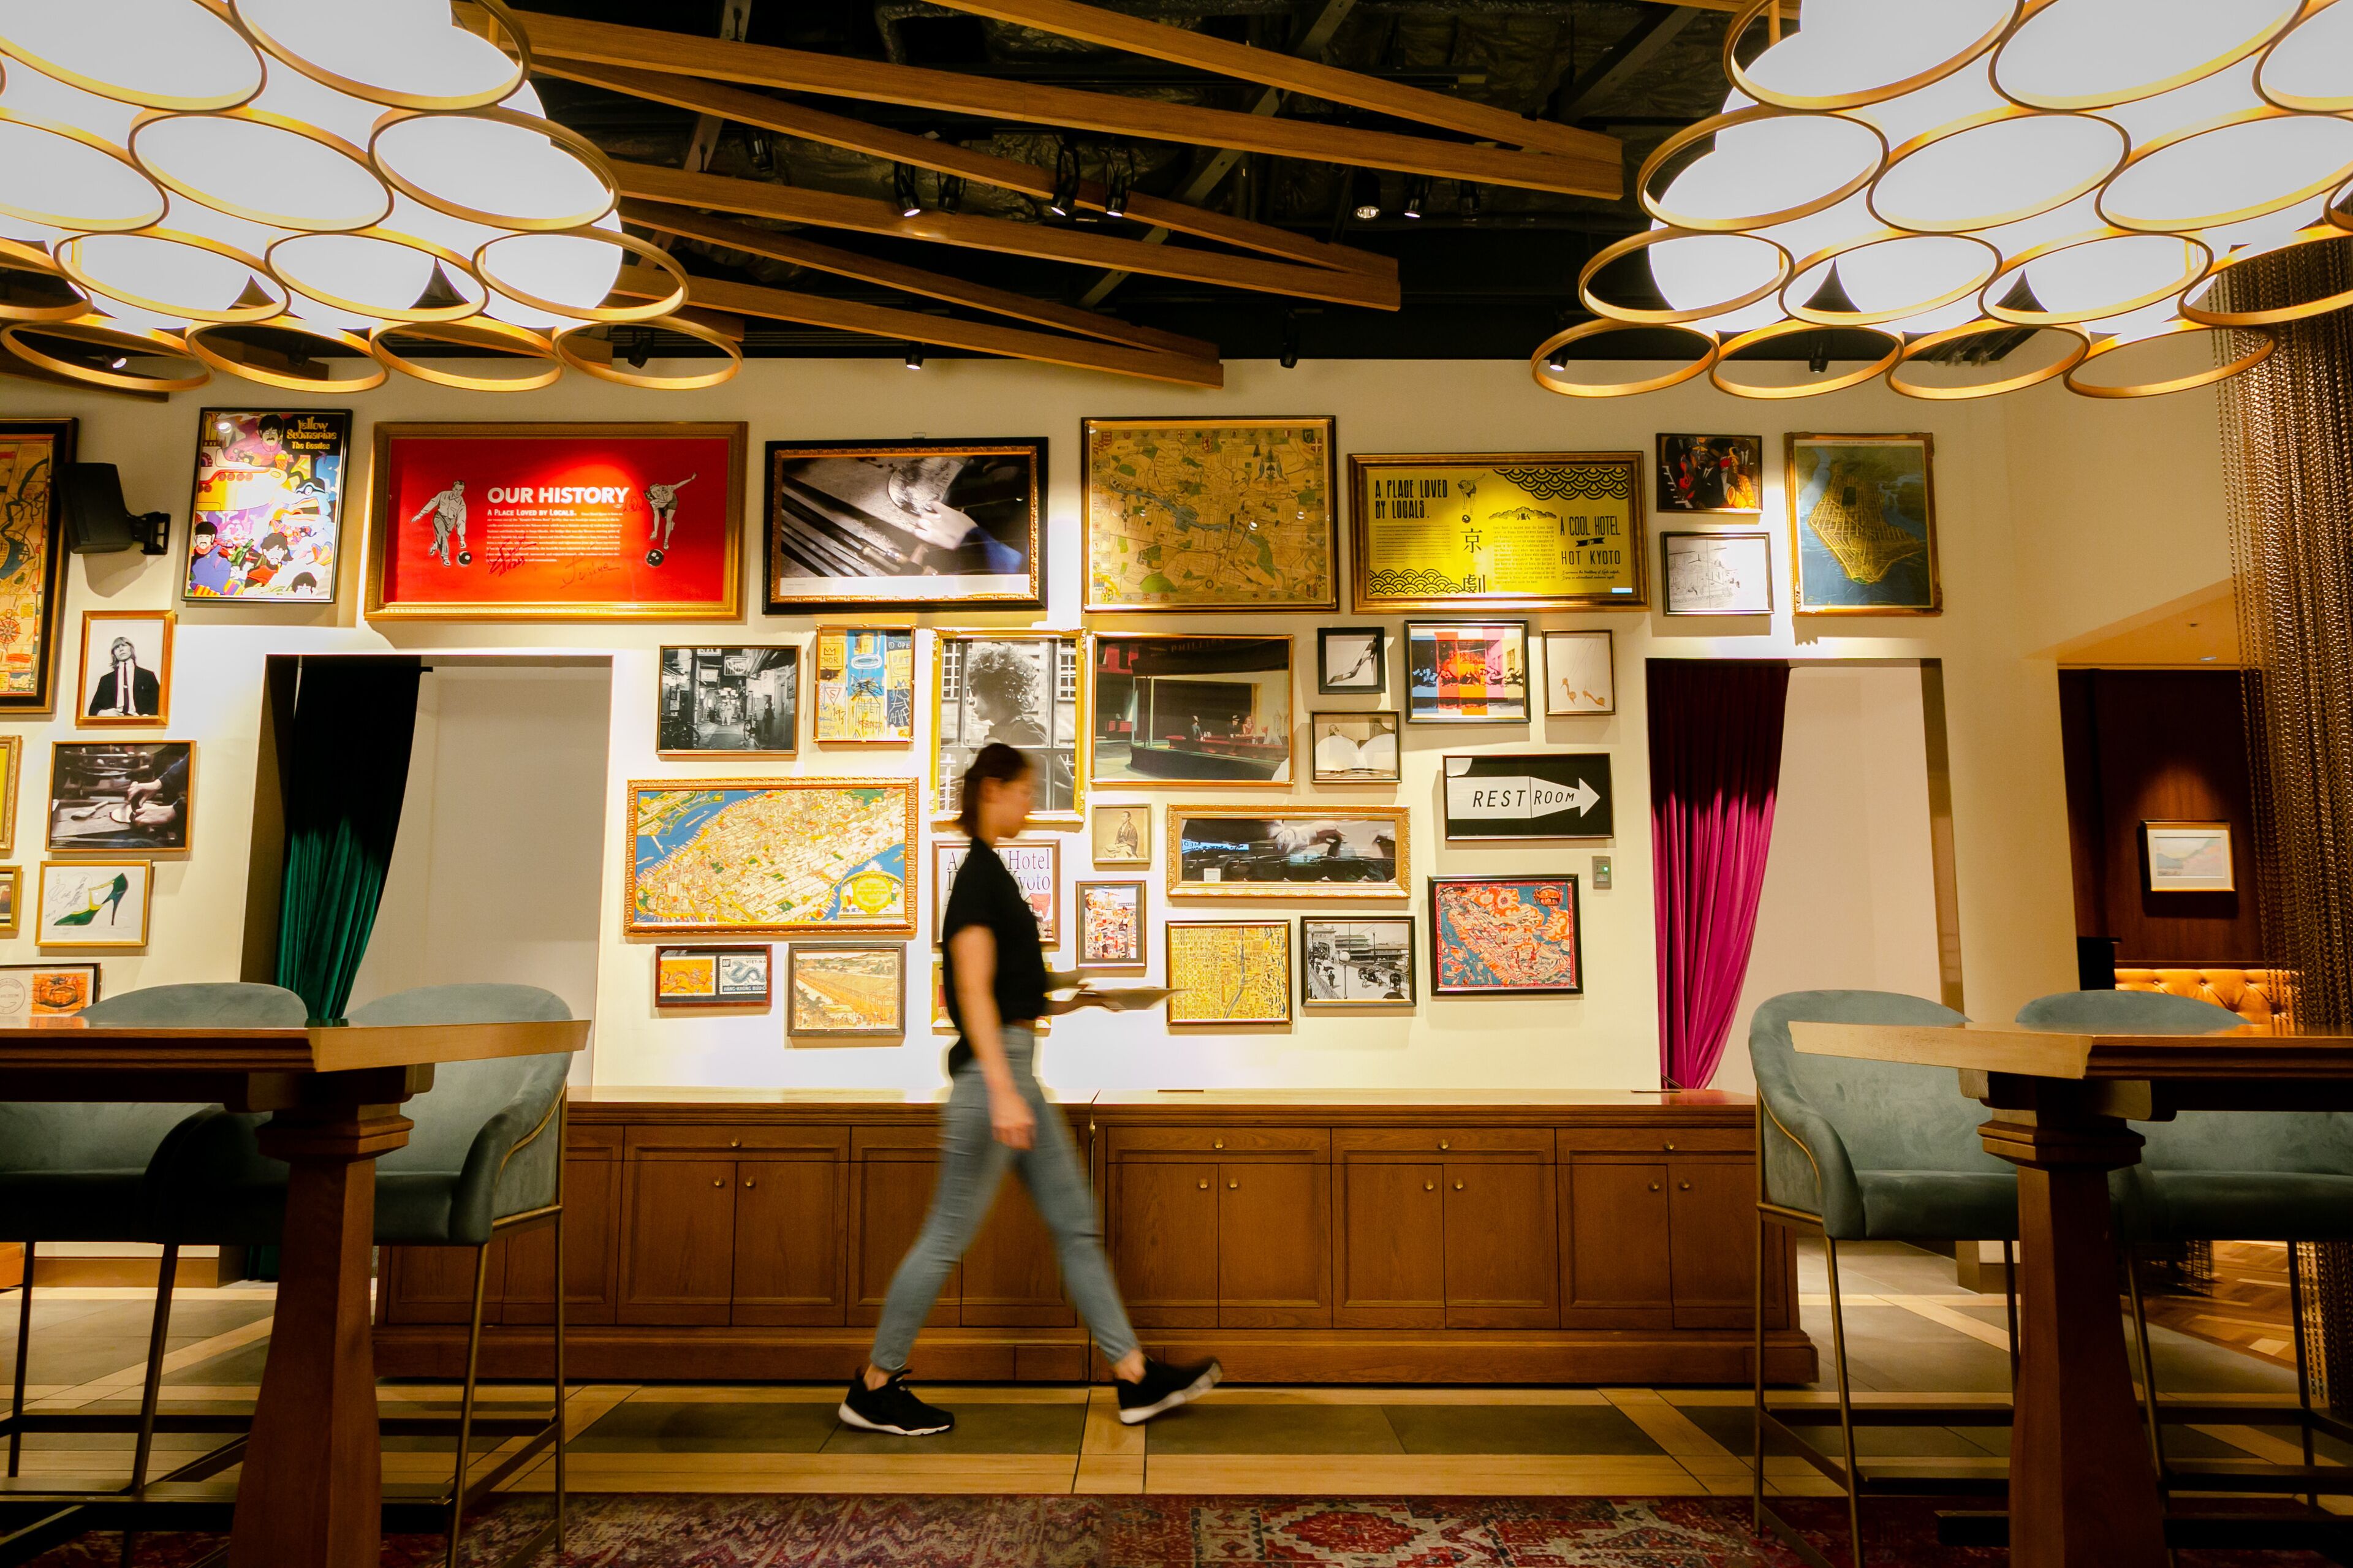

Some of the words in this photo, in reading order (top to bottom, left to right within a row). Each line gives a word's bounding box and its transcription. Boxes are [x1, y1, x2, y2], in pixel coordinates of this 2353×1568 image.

[297, 416, 328, 433] Yellow
[286, 429, 337, 440] Submarine
[291, 441, 304, 450] The
[487, 487, 534, 504] OUR
[538, 487, 630, 504] HISTORY
[1375, 480, 1381, 498] A
[1387, 480, 1414, 498] PLACE
[1420, 479, 1447, 498] LOVED
[1375, 500, 1386, 519] BY
[1392, 500, 1430, 519] LOCALS.
[1560, 516, 1565, 536] A
[1569, 516, 1591, 536] COOL
[1594, 515, 1621, 536] HOTEL
[1561, 550, 1581, 565] HOT
[1590, 550, 1621, 565] KYOTO
[1472, 790, 1526, 808] REST
[1533, 790, 1575, 805] ROOM
[946, 851, 959, 870] A
[1007, 849, 1050, 869] Hotel
[1008, 871, 1050, 898] yoto
